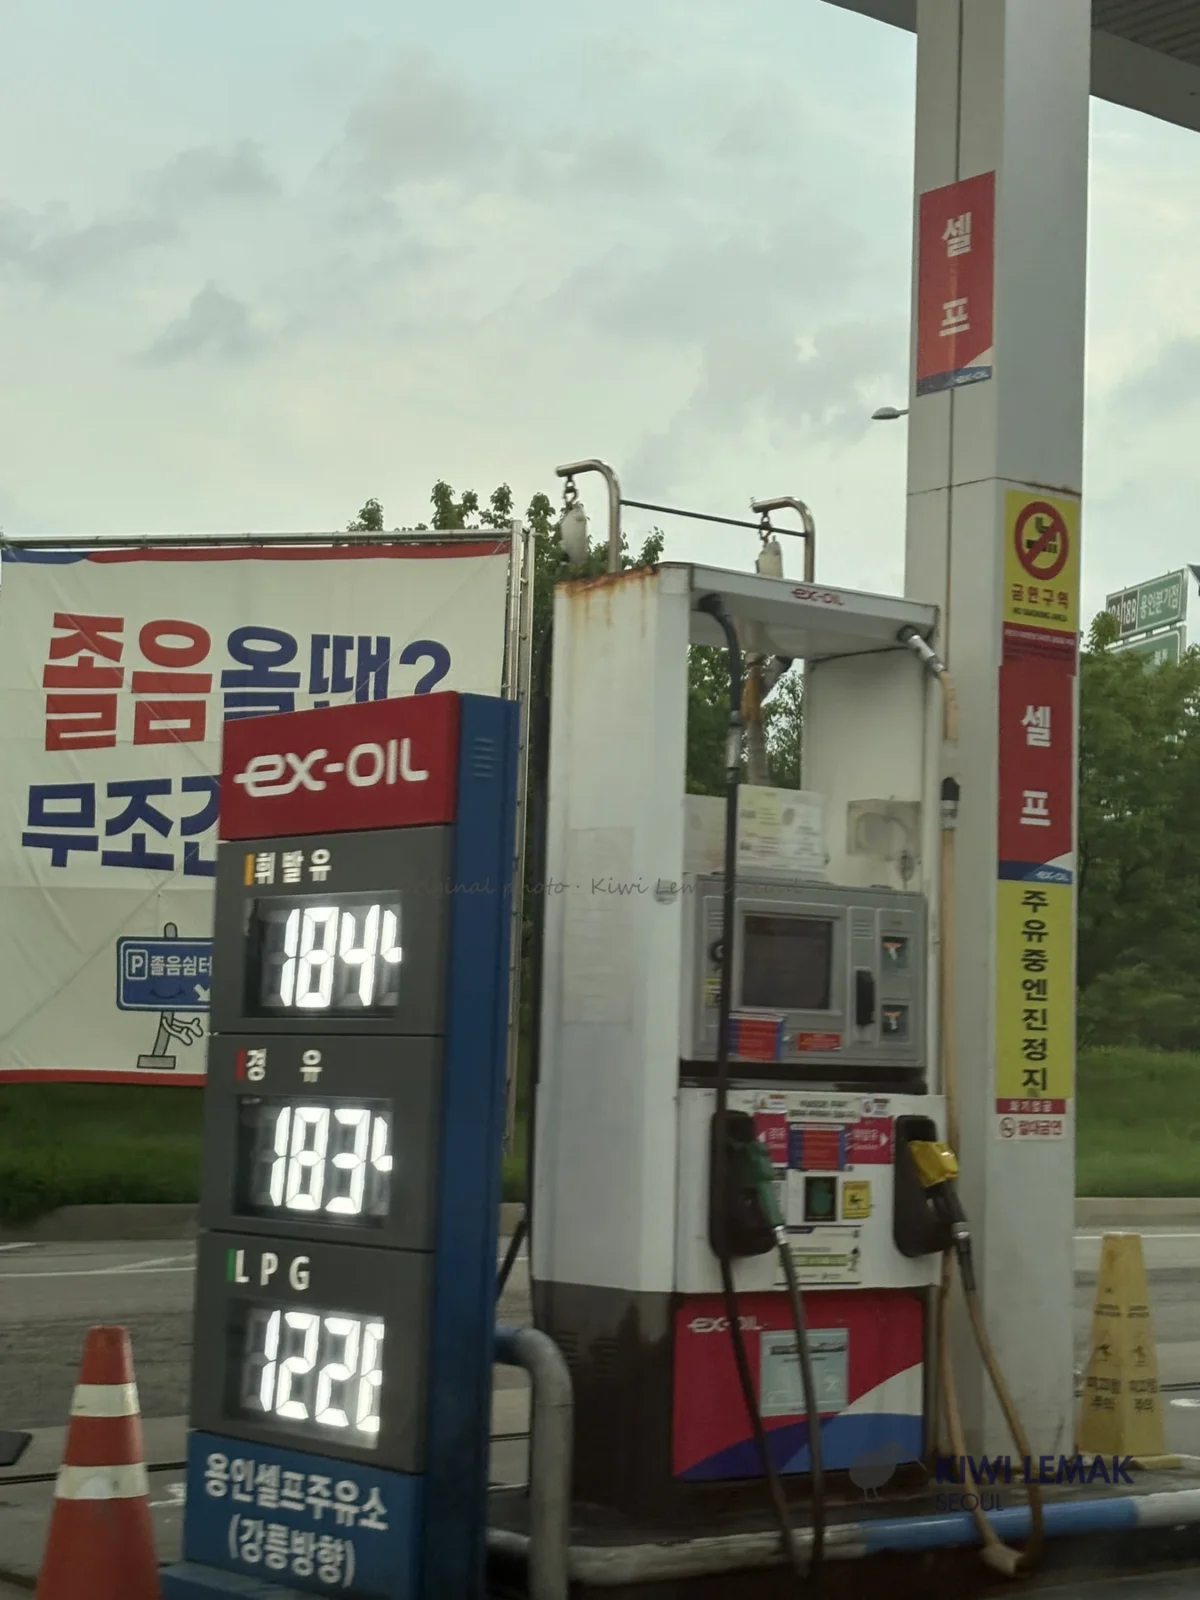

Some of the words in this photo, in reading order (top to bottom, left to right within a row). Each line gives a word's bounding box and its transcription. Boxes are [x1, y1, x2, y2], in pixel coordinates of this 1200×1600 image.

[233, 737, 429, 798] ex-OIL
[204, 1453, 389, 1531] 용인셀프주유소
[228, 1513, 357, 1589] (강릉방향)
